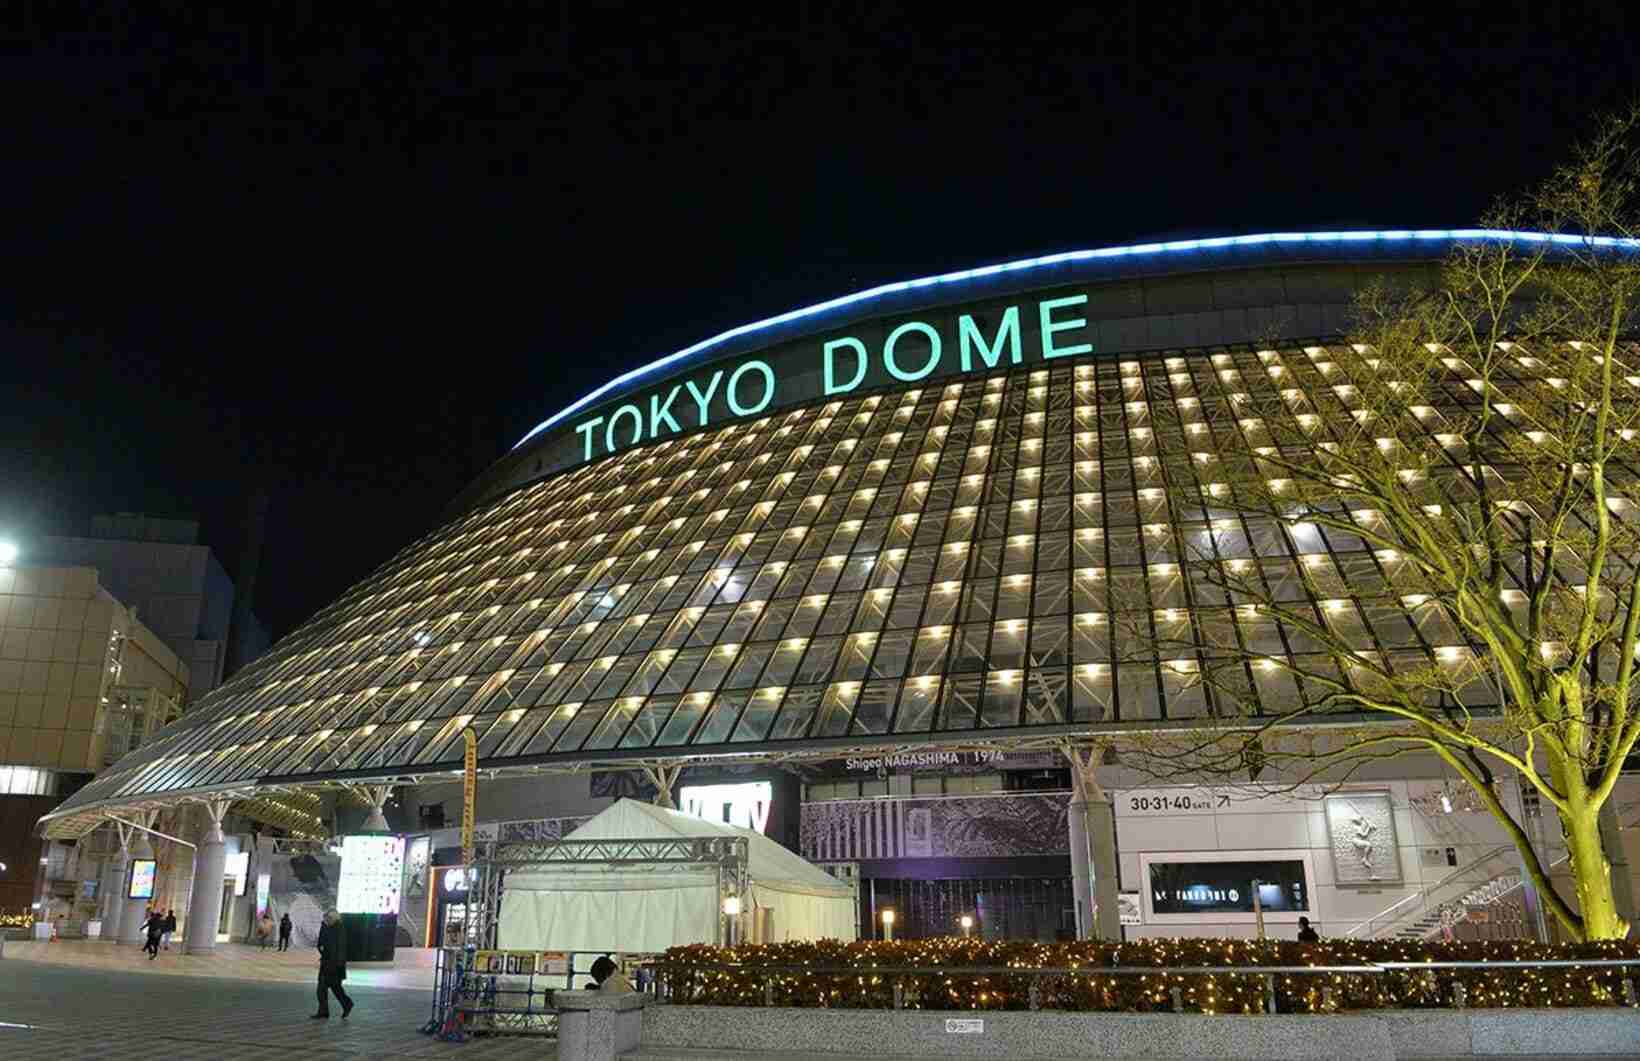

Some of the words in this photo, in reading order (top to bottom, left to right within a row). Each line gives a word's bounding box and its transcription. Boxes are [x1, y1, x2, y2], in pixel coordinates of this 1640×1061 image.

[575, 360, 776, 462] TOKYO
[823, 294, 1093, 396] DOME
[846, 758, 881, 771] Shigeo
[885, 751, 959, 767] NAGASHIMA
